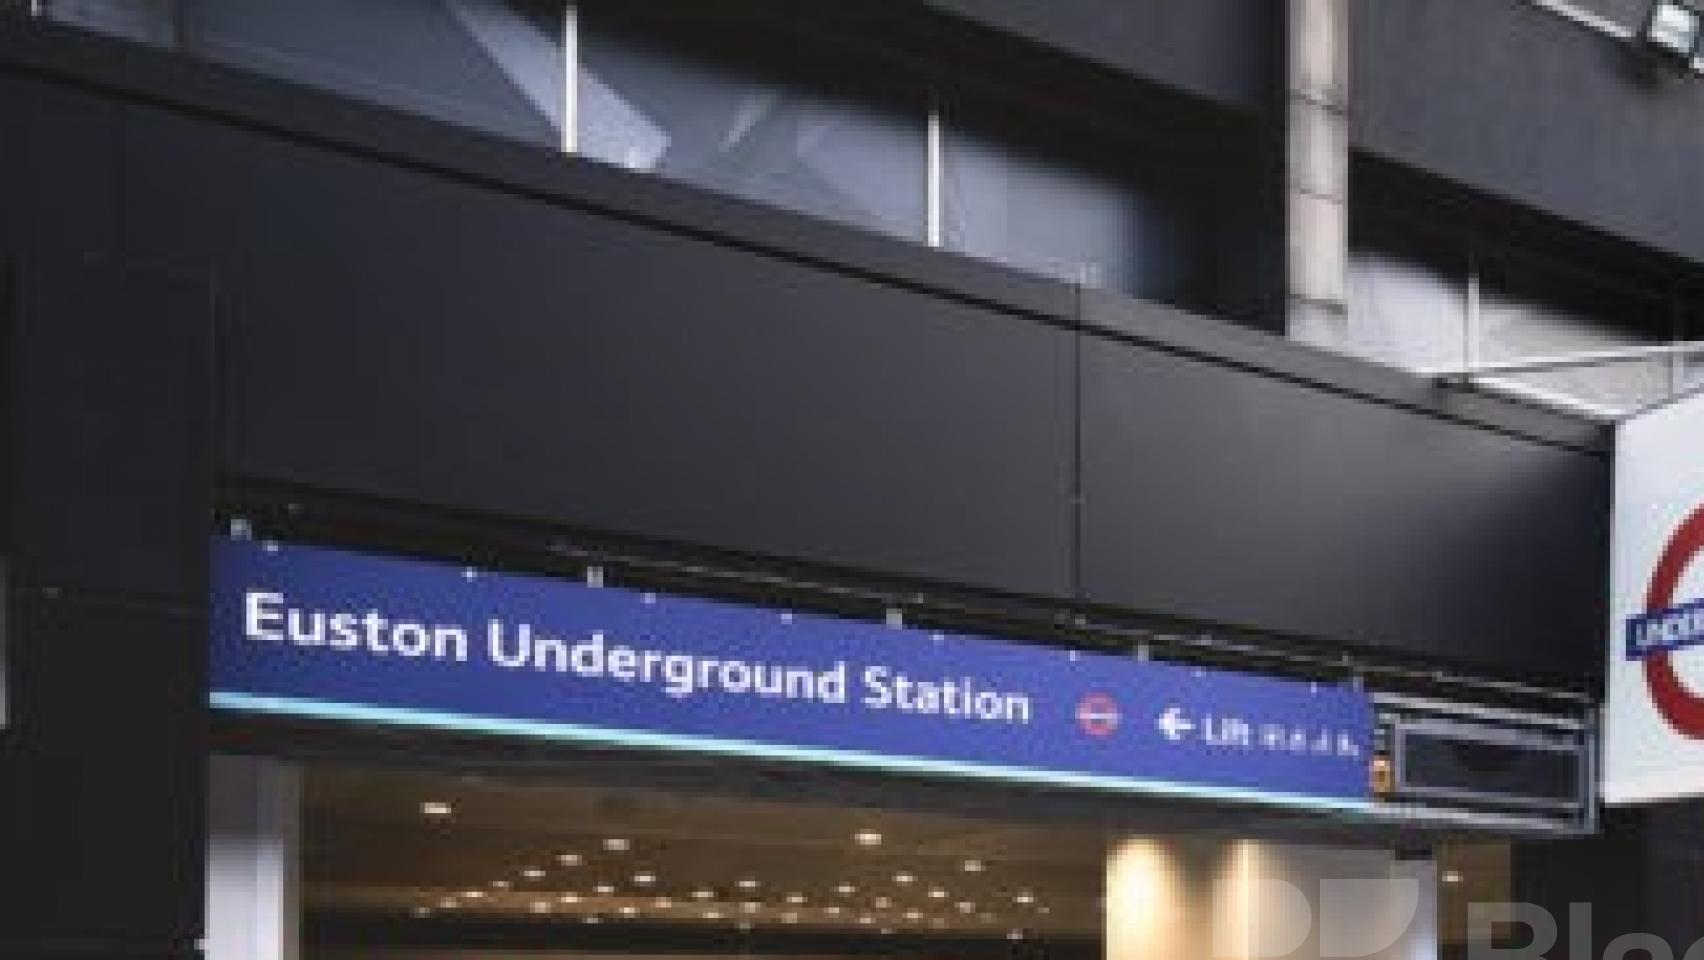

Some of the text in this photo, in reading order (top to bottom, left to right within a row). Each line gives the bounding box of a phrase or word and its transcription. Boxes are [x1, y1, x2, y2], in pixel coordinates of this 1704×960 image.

[245, 591, 1031, 725] Euston Underground Station
[1205, 715, 1249, 746] Lift
